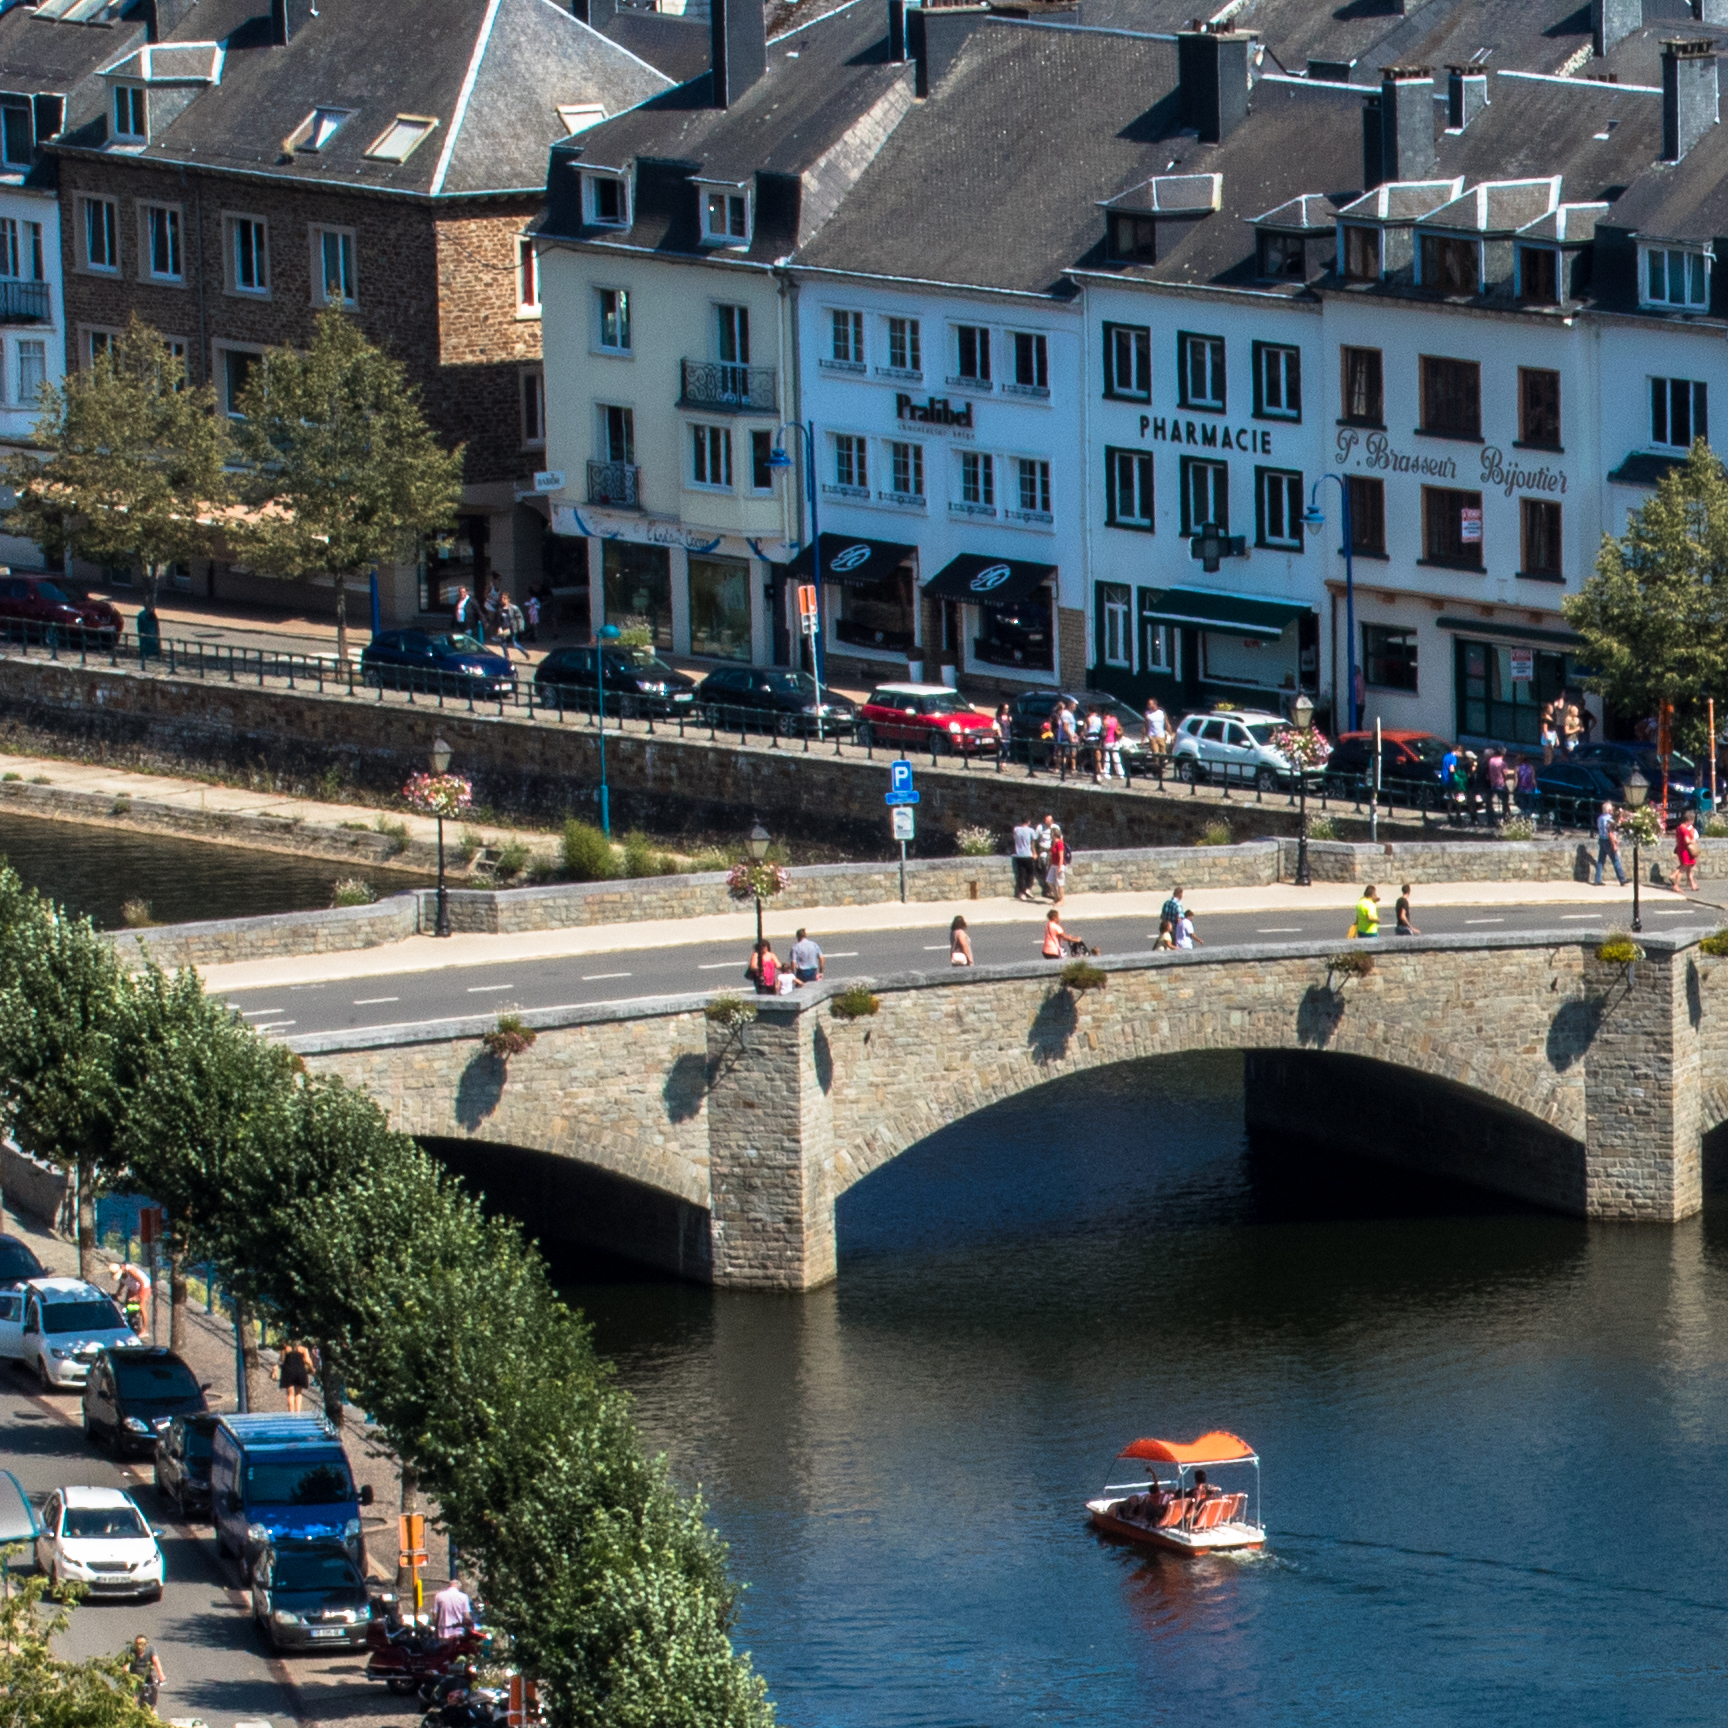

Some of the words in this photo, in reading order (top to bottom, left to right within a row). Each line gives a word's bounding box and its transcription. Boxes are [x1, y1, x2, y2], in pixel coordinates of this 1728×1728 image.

[896, 393, 973, 428] Pralibel
[1139, 415, 1272, 454] PHARMACIE
[1366, 432, 1457, 479] Brasseur
[1480, 446, 1567, 497] Bijoutier
[894, 766, 909, 787] P
